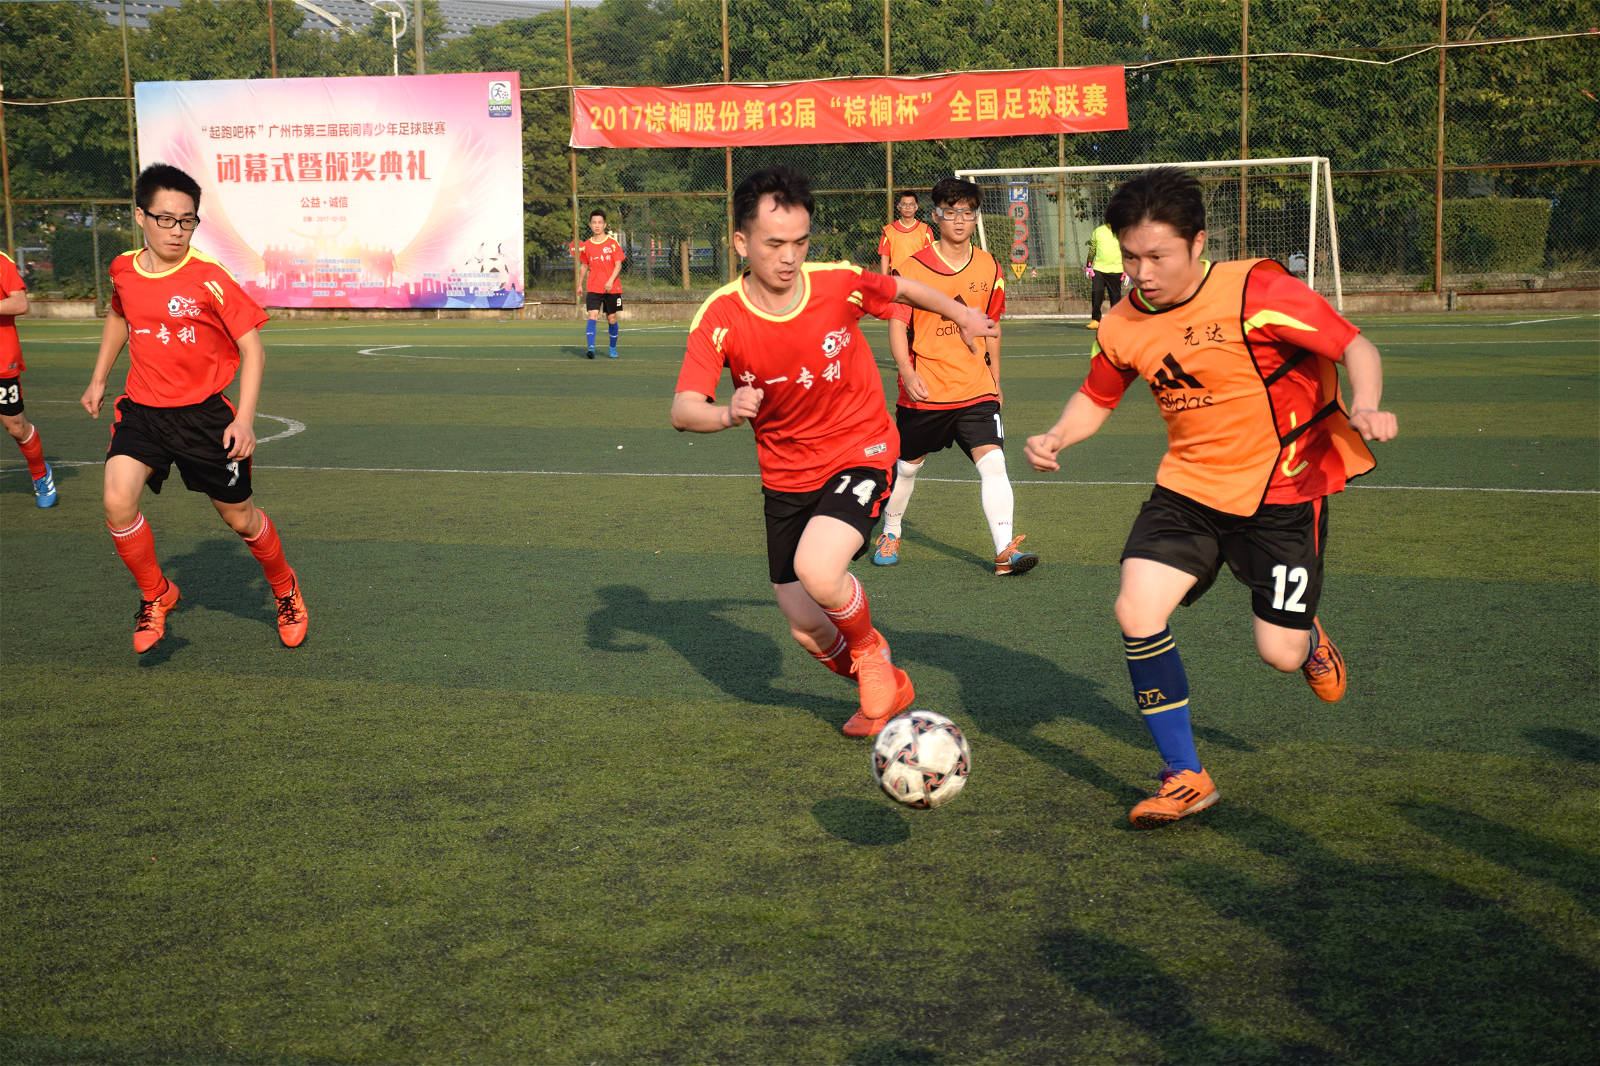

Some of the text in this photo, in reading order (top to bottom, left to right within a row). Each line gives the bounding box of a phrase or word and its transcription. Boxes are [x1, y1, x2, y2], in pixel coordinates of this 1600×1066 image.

[590, 97, 816, 134] 2017棕榈股份第13届
[948, 83, 1108, 122] 全国足球联赛
[216, 150, 432, 183] 闭幕式暨颁奖典礼
[128, 322, 197, 345] 一专利
[936, 322, 960, 336] adi
[1184, 323, 1226, 346] 元达
[0, 385, 19, 405] 23
[993, 413, 1004, 440] 1
[833, 475, 877, 507] 14
[1271, 564, 1309, 613] 12
